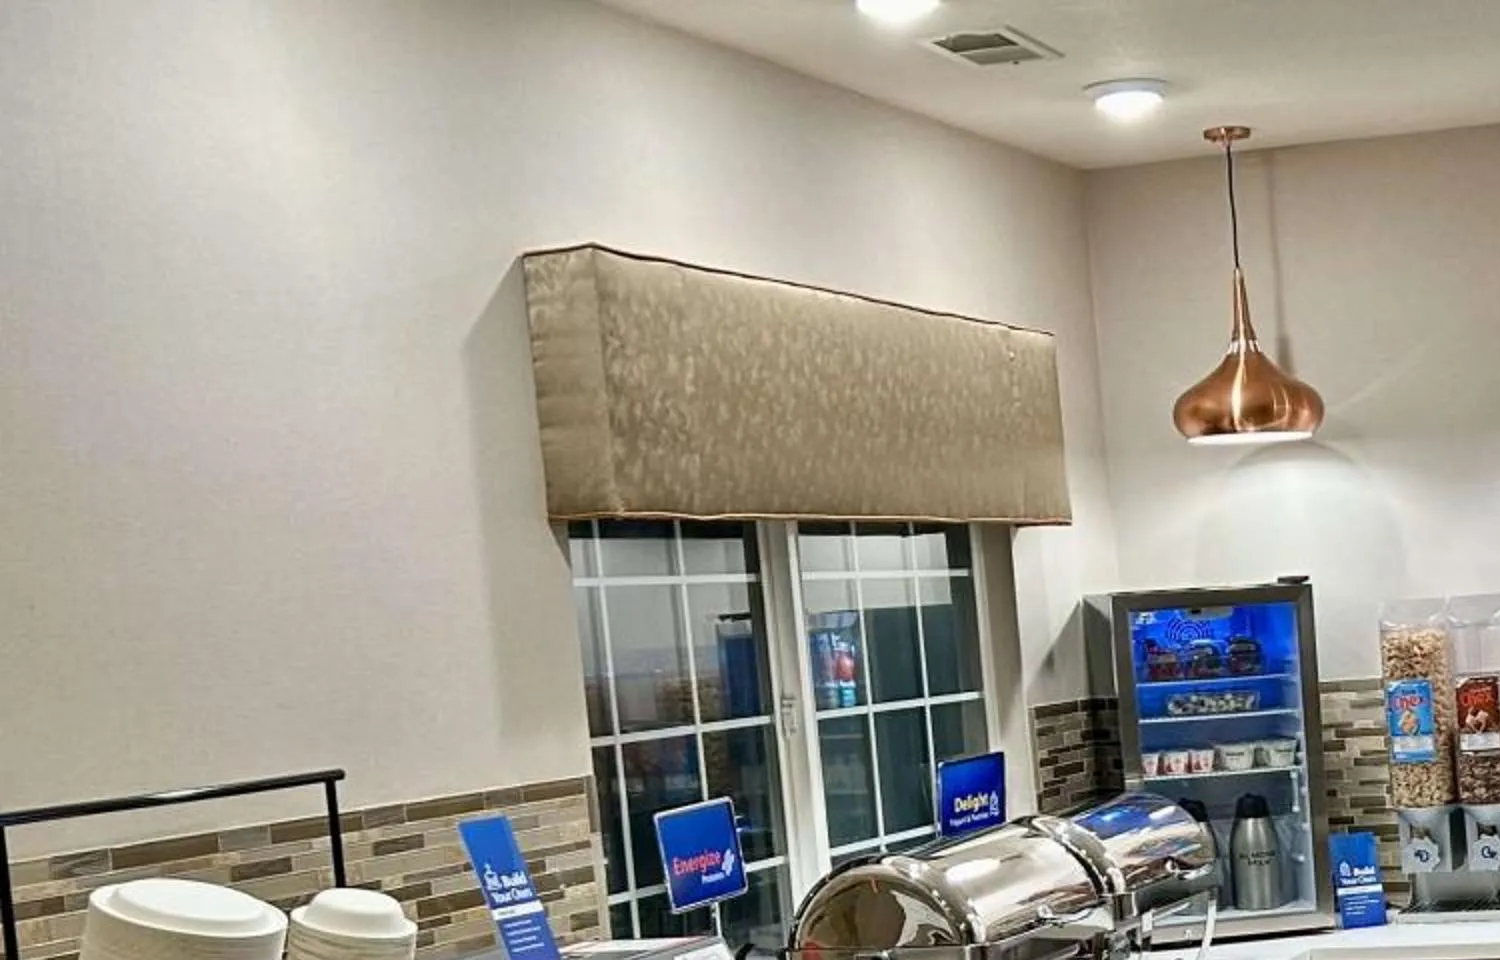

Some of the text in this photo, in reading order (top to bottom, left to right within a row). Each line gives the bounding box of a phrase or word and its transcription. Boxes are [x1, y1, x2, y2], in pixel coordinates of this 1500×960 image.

[953, 792, 989, 814] Delight
[673, 851, 721, 876] Energize
[1353, 865, 1375, 876] Build
[500, 870, 529, 888] Build
[490, 889, 513, 904] Your
